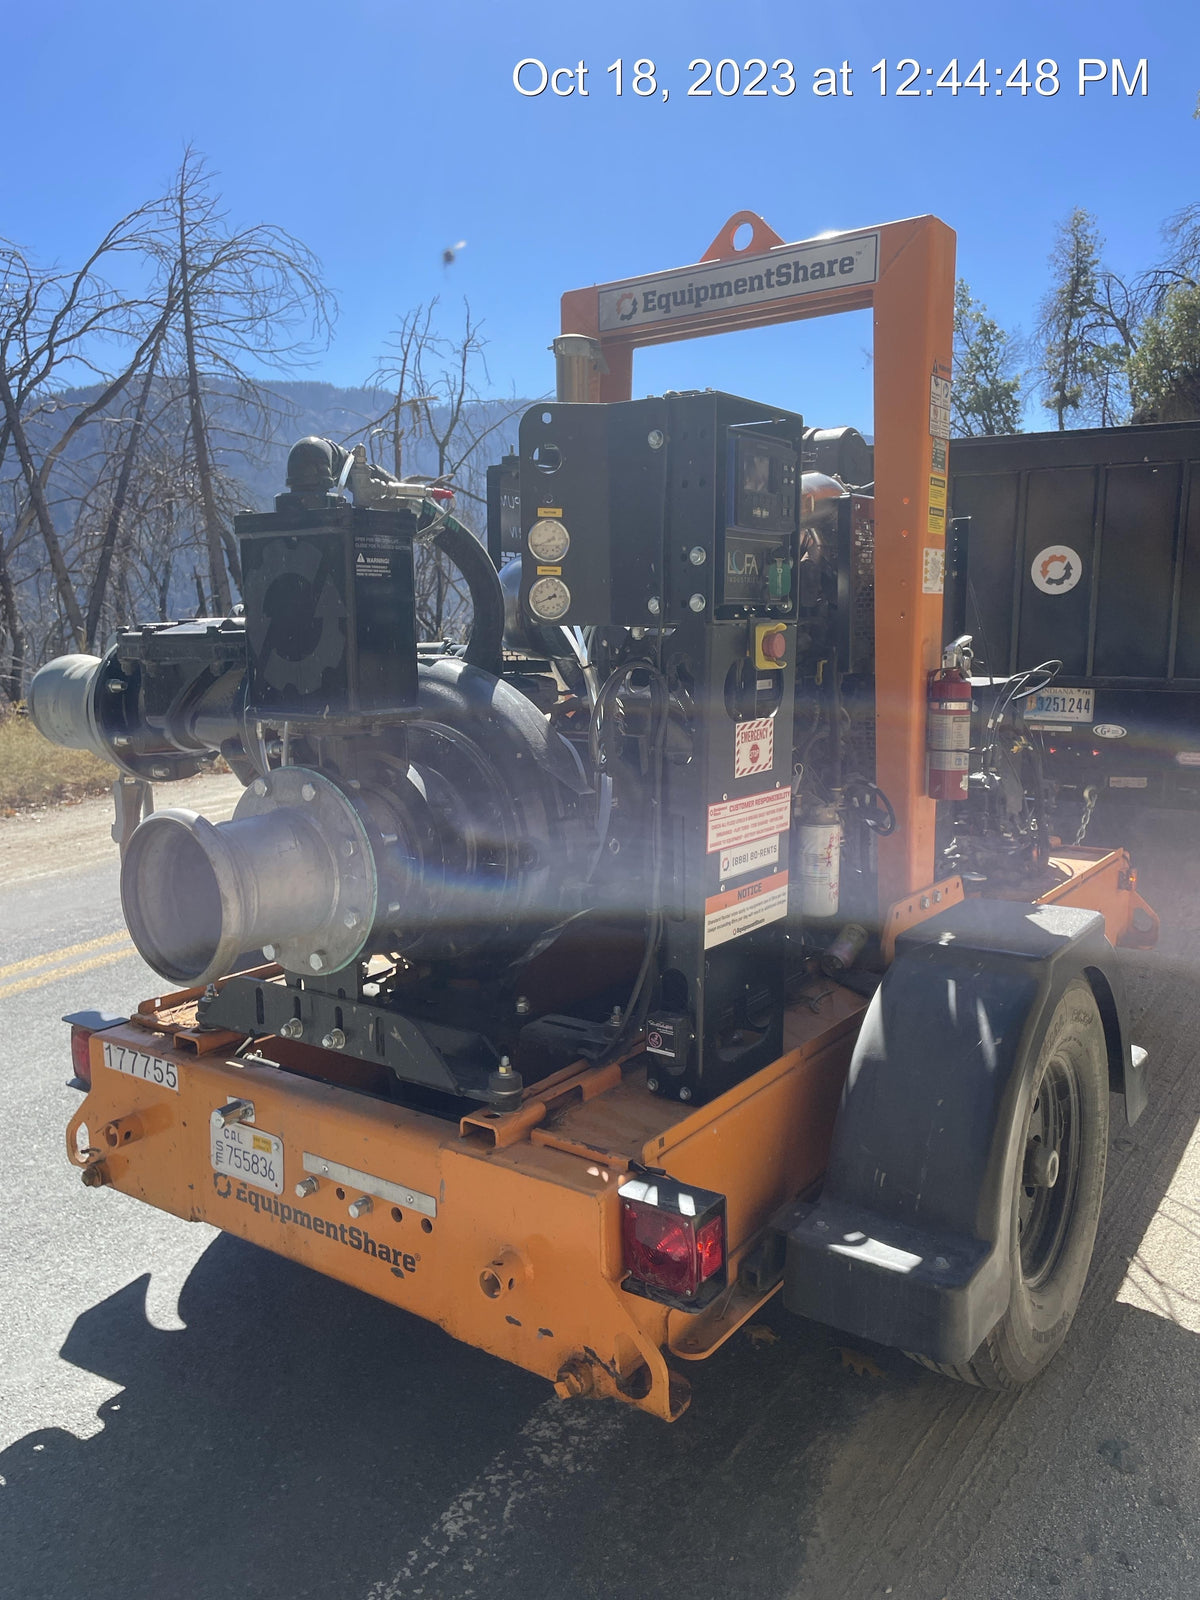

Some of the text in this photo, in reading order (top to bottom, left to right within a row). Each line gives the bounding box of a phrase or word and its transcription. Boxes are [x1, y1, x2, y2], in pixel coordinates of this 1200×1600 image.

[642, 255, 855, 314] EquipmentShare
[1038, 697, 1091, 714] 3251244
[741, 728, 768, 743] EMERGENCY
[737, 882, 762, 900] NOTICE
[104, 1044, 177, 1088] 177755
[223, 1128, 243, 1144] CAL
[226, 1144, 276, 1182] 755836
[236, 1181, 416, 1273] EquipmentShare
